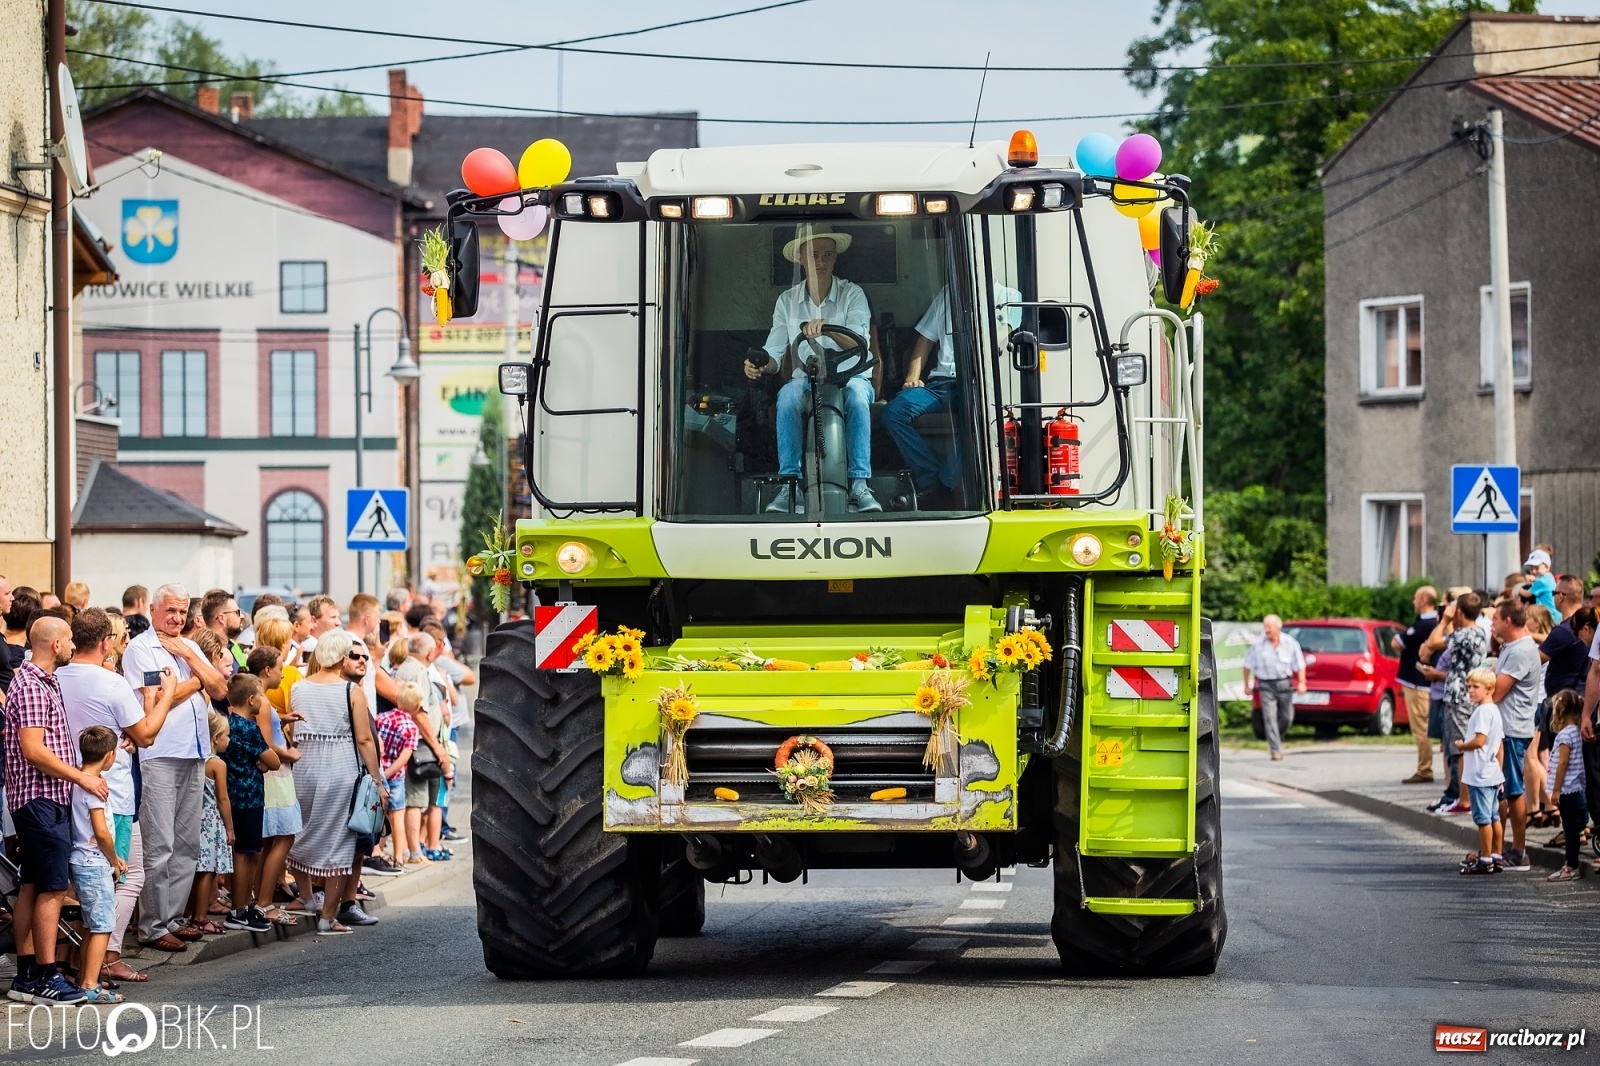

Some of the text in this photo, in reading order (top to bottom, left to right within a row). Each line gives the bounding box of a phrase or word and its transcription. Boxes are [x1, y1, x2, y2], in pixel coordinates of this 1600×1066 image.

[759, 193, 846, 206] CLAAS
[176, 281, 255, 299] WIELKIE
[750, 536, 892, 560] LEXION
